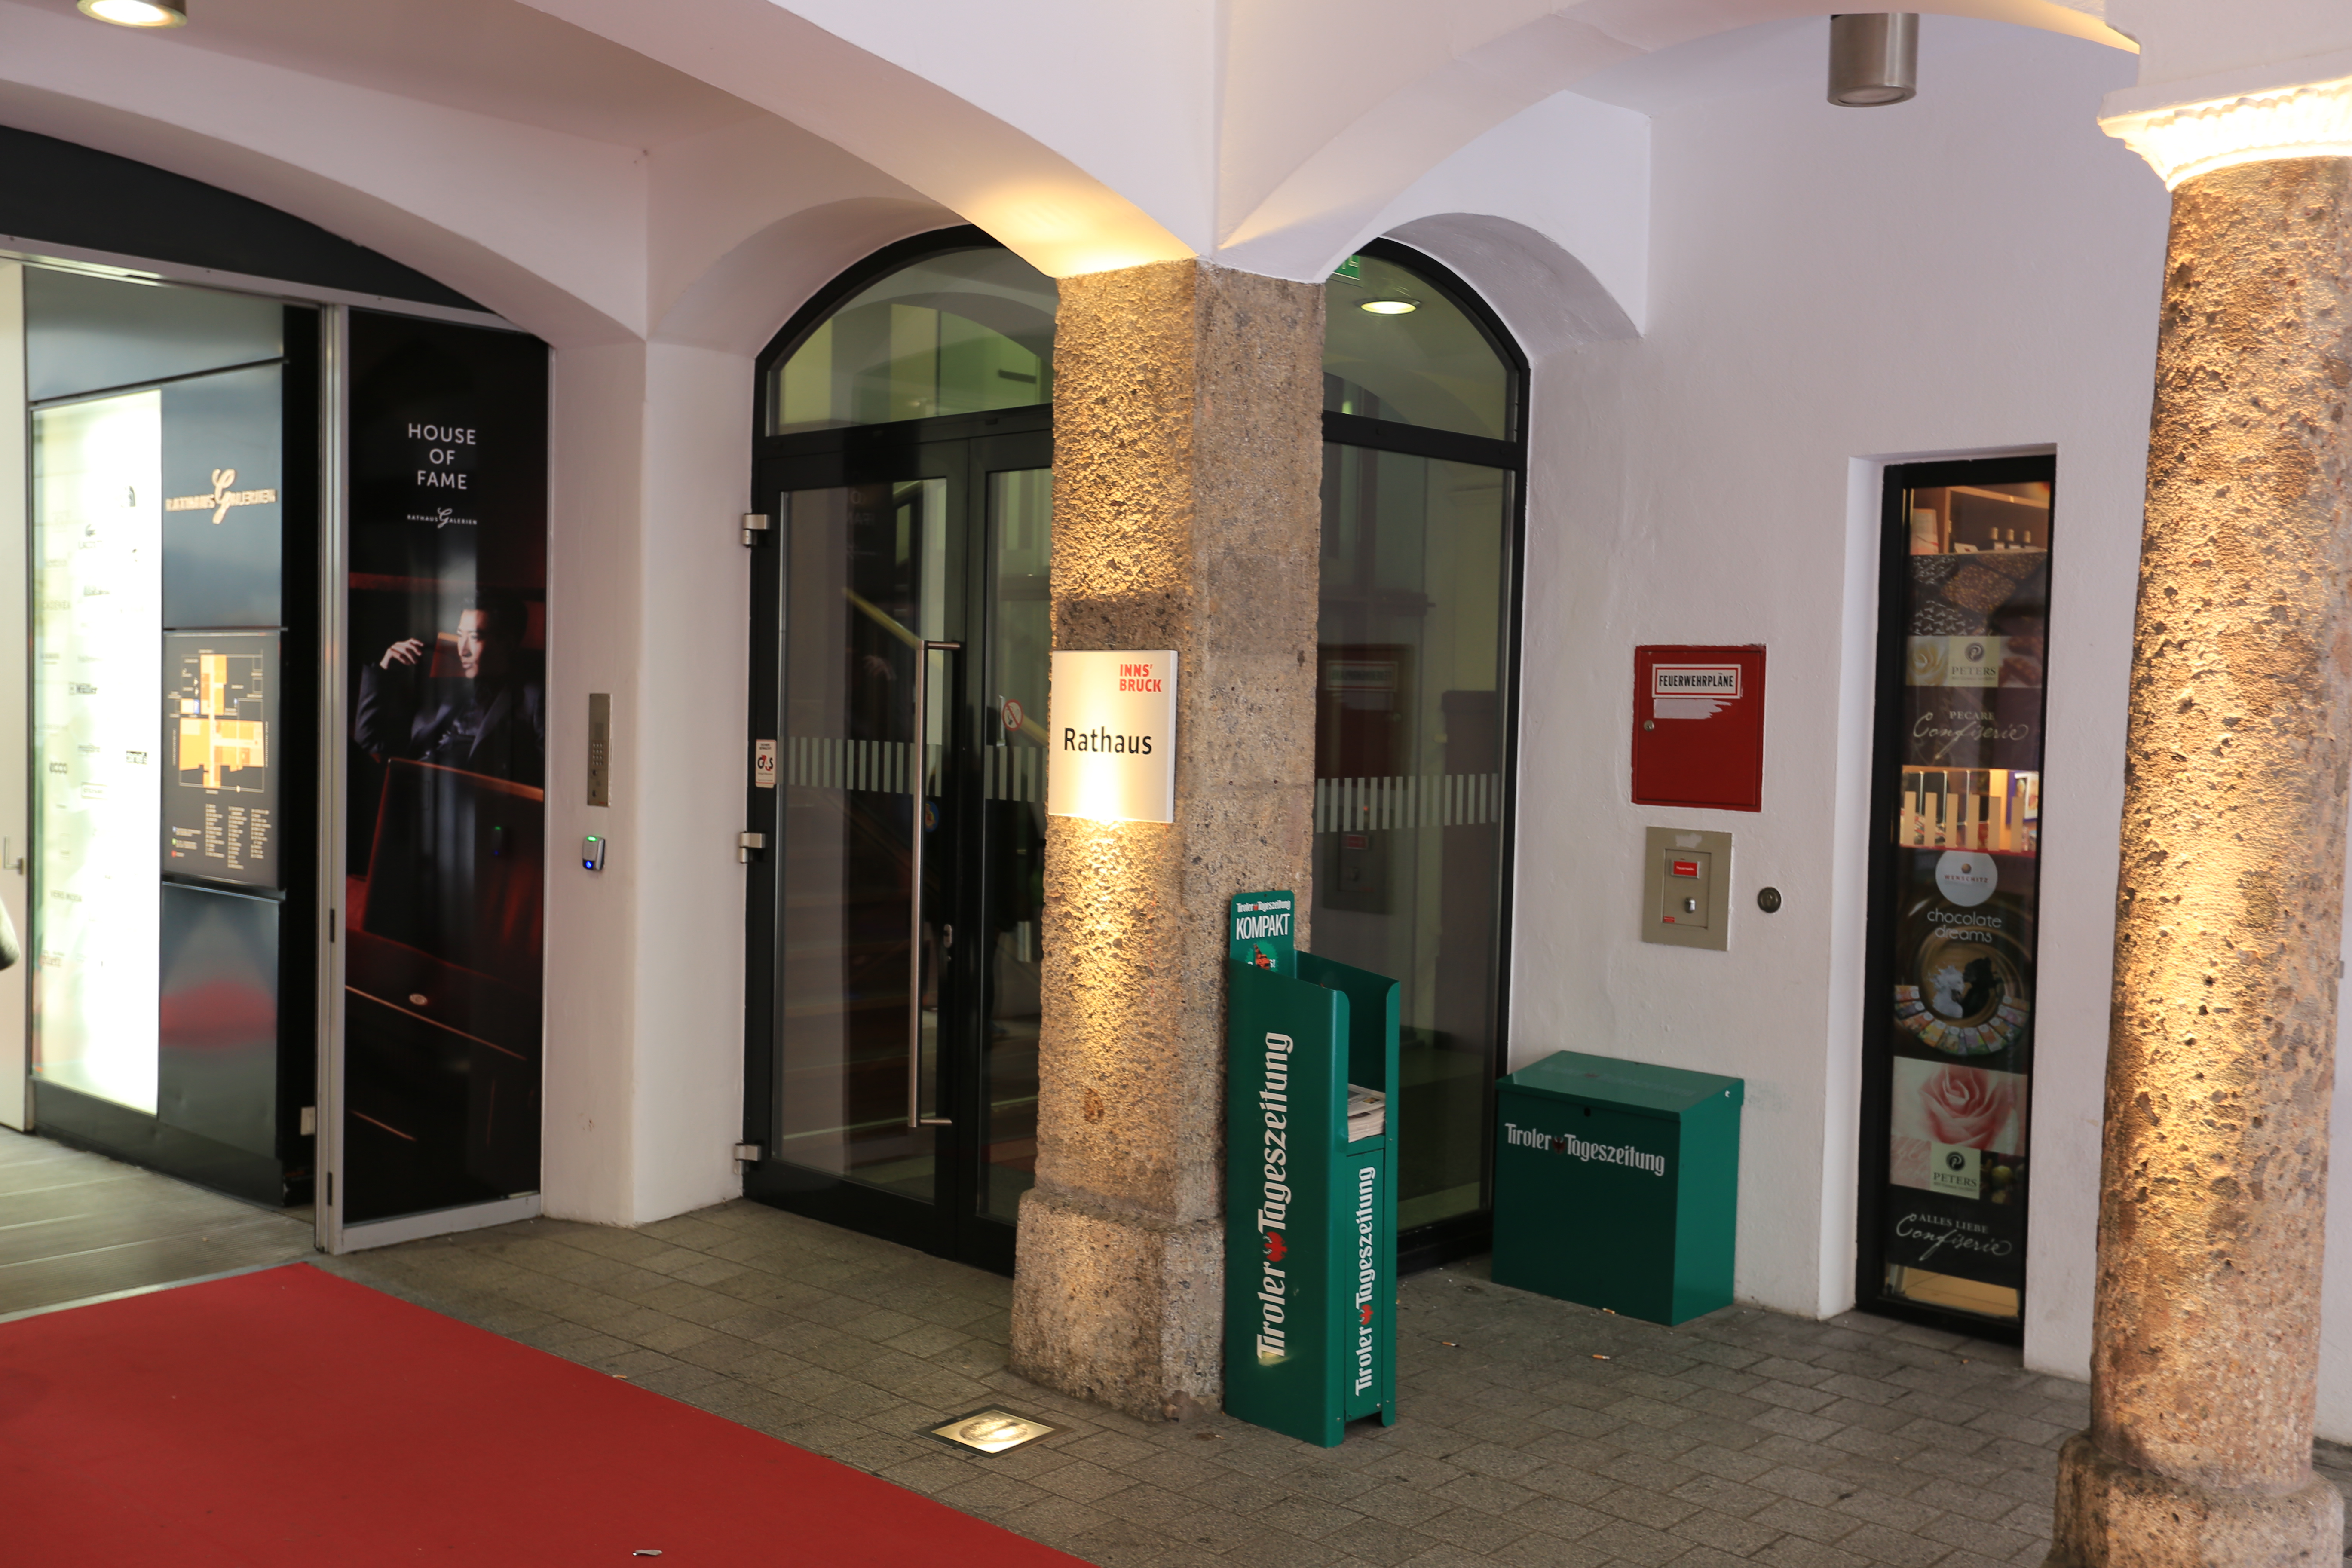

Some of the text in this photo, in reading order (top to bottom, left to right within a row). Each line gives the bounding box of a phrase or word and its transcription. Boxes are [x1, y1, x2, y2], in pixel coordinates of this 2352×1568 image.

[408, 423, 476, 445] HOUSE
[429, 448, 455, 465] OF
[417, 470, 467, 490] FAME
[1658, 672, 1734, 688] FEUERWEHRPLÄNE
[1951, 666, 1996, 676] PETERS
[1119, 678, 1162, 692] BRUCK
[1949, 710, 1996, 721] PECARE
[1064, 726, 1153, 755] Rathaus
[1912, 711, 2029, 760] Confiserie
[1944, 874, 1989, 884] WENSCHITZ
[1236, 899, 1291, 913] Tiroler Tageszeitung
[1236, 913, 1291, 940] KOMPAKT
[1927, 908, 2002, 928] chocolate
[1935, 924, 1992, 943] dreams
[1504, 1121, 1665, 1177] Tiroler Tageszeitung
[1933, 1171, 1977, 1188] PETERS
[1257, 1032, 1294, 1359] Tiroler Tageszeitung
[1918, 1213, 1989, 1234] ALLES LIEBE
[1896, 1212, 2013, 1262] Confiserie
[1355, 1166, 1376, 1396] Tiroler Tageszeitung
